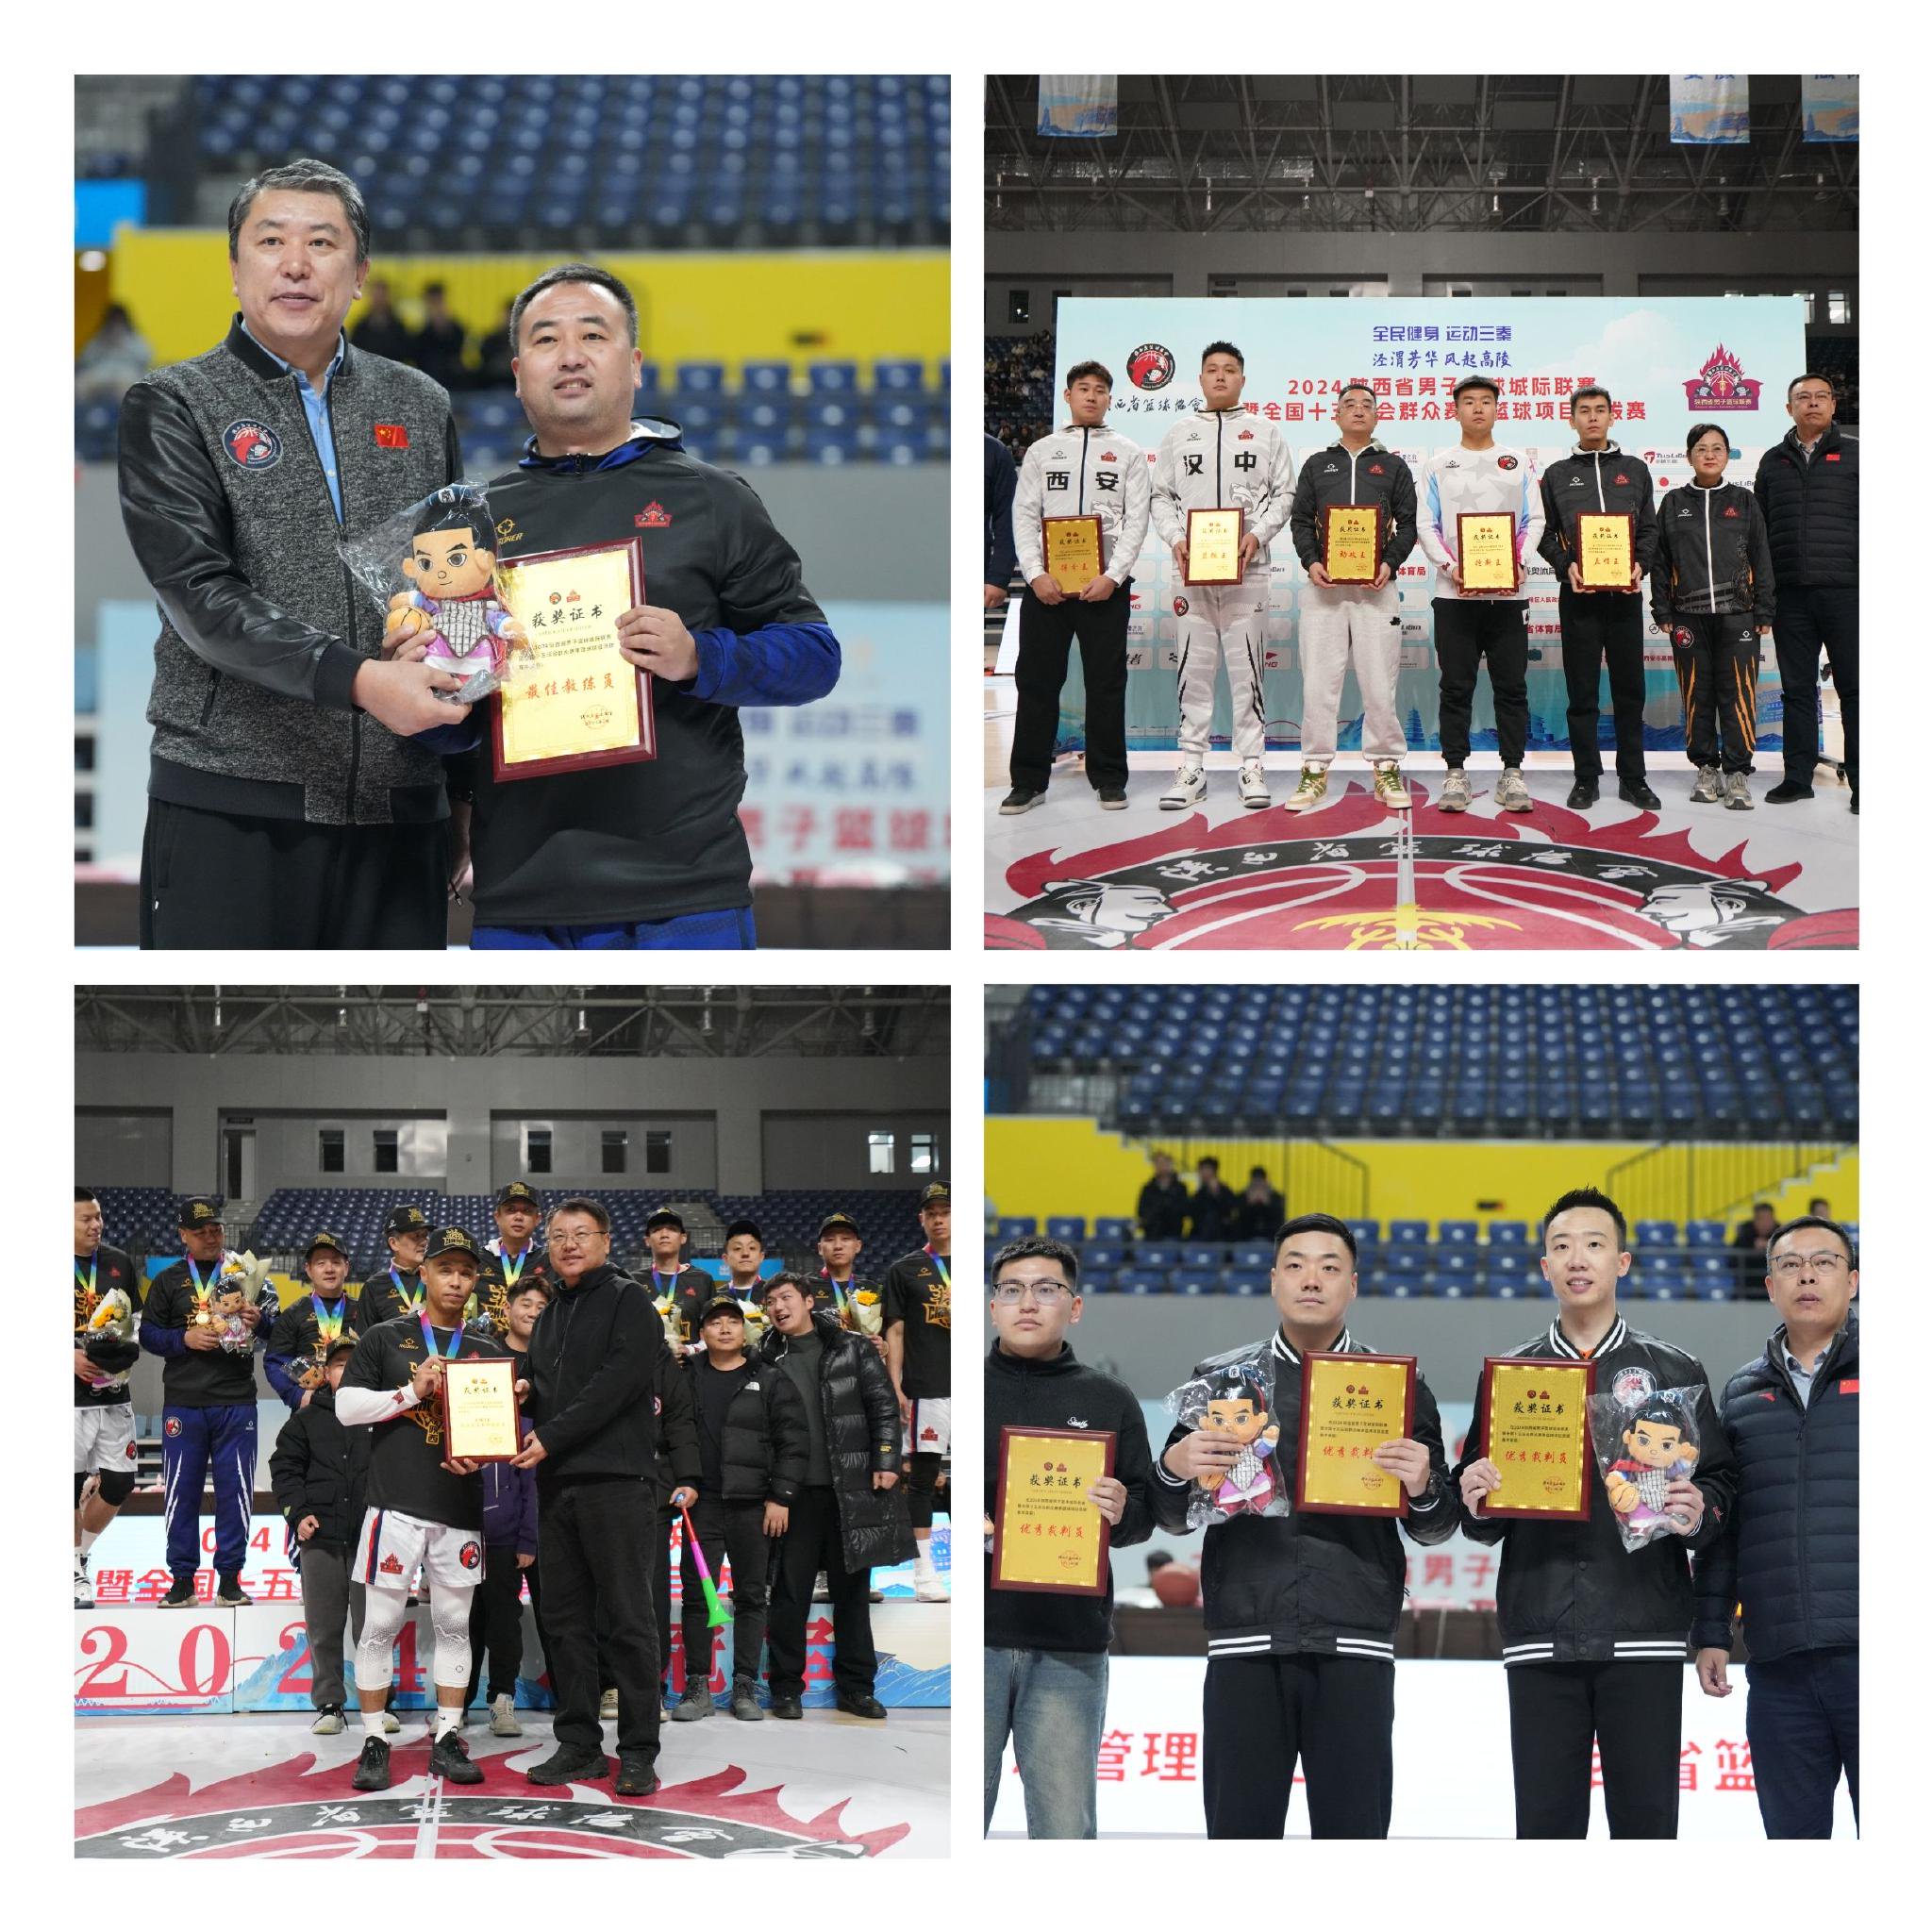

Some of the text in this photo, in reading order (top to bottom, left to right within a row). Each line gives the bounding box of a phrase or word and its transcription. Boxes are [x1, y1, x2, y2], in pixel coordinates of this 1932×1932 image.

[1373, 325, 1512, 341] 全民健身 运动三秦
[1373, 350, 1512, 369] 泾渭芳华 风起高陵
[1046, 472, 1119, 491] 西安
[532, 605, 603, 629] 获奖证书
[525, 674, 616, 699] 最佳教练员
[1332, 1397, 1384, 1409] 获奖证书
[1513, 1401, 1565, 1415] 获奖证书
[1324, 1445, 1374, 1459] 优秀裁判
[1505, 1450, 1567, 1464] 优秀裁判员
[1029, 1474, 1082, 1489] 获奖证书
[1020, 1524, 1085, 1540] 优秀裁判员
